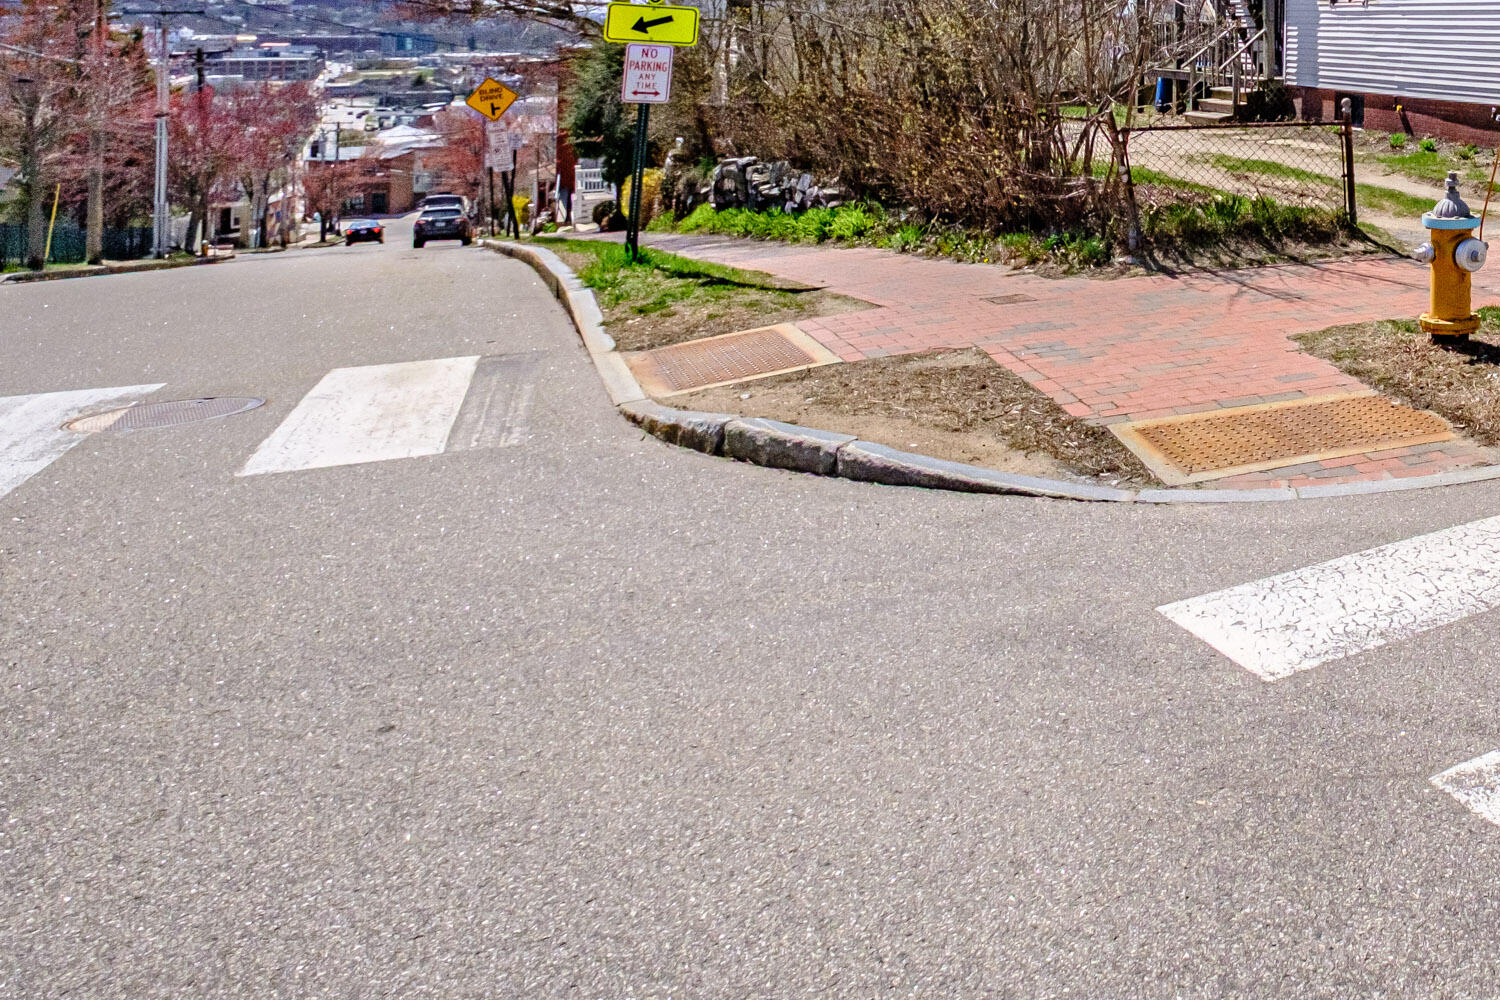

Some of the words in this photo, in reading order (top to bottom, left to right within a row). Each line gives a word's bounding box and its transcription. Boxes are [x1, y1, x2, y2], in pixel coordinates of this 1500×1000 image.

[641, 48, 658, 58] NO
[629, 60, 668, 72] PARKING
[638, 73, 656, 81] ANY
